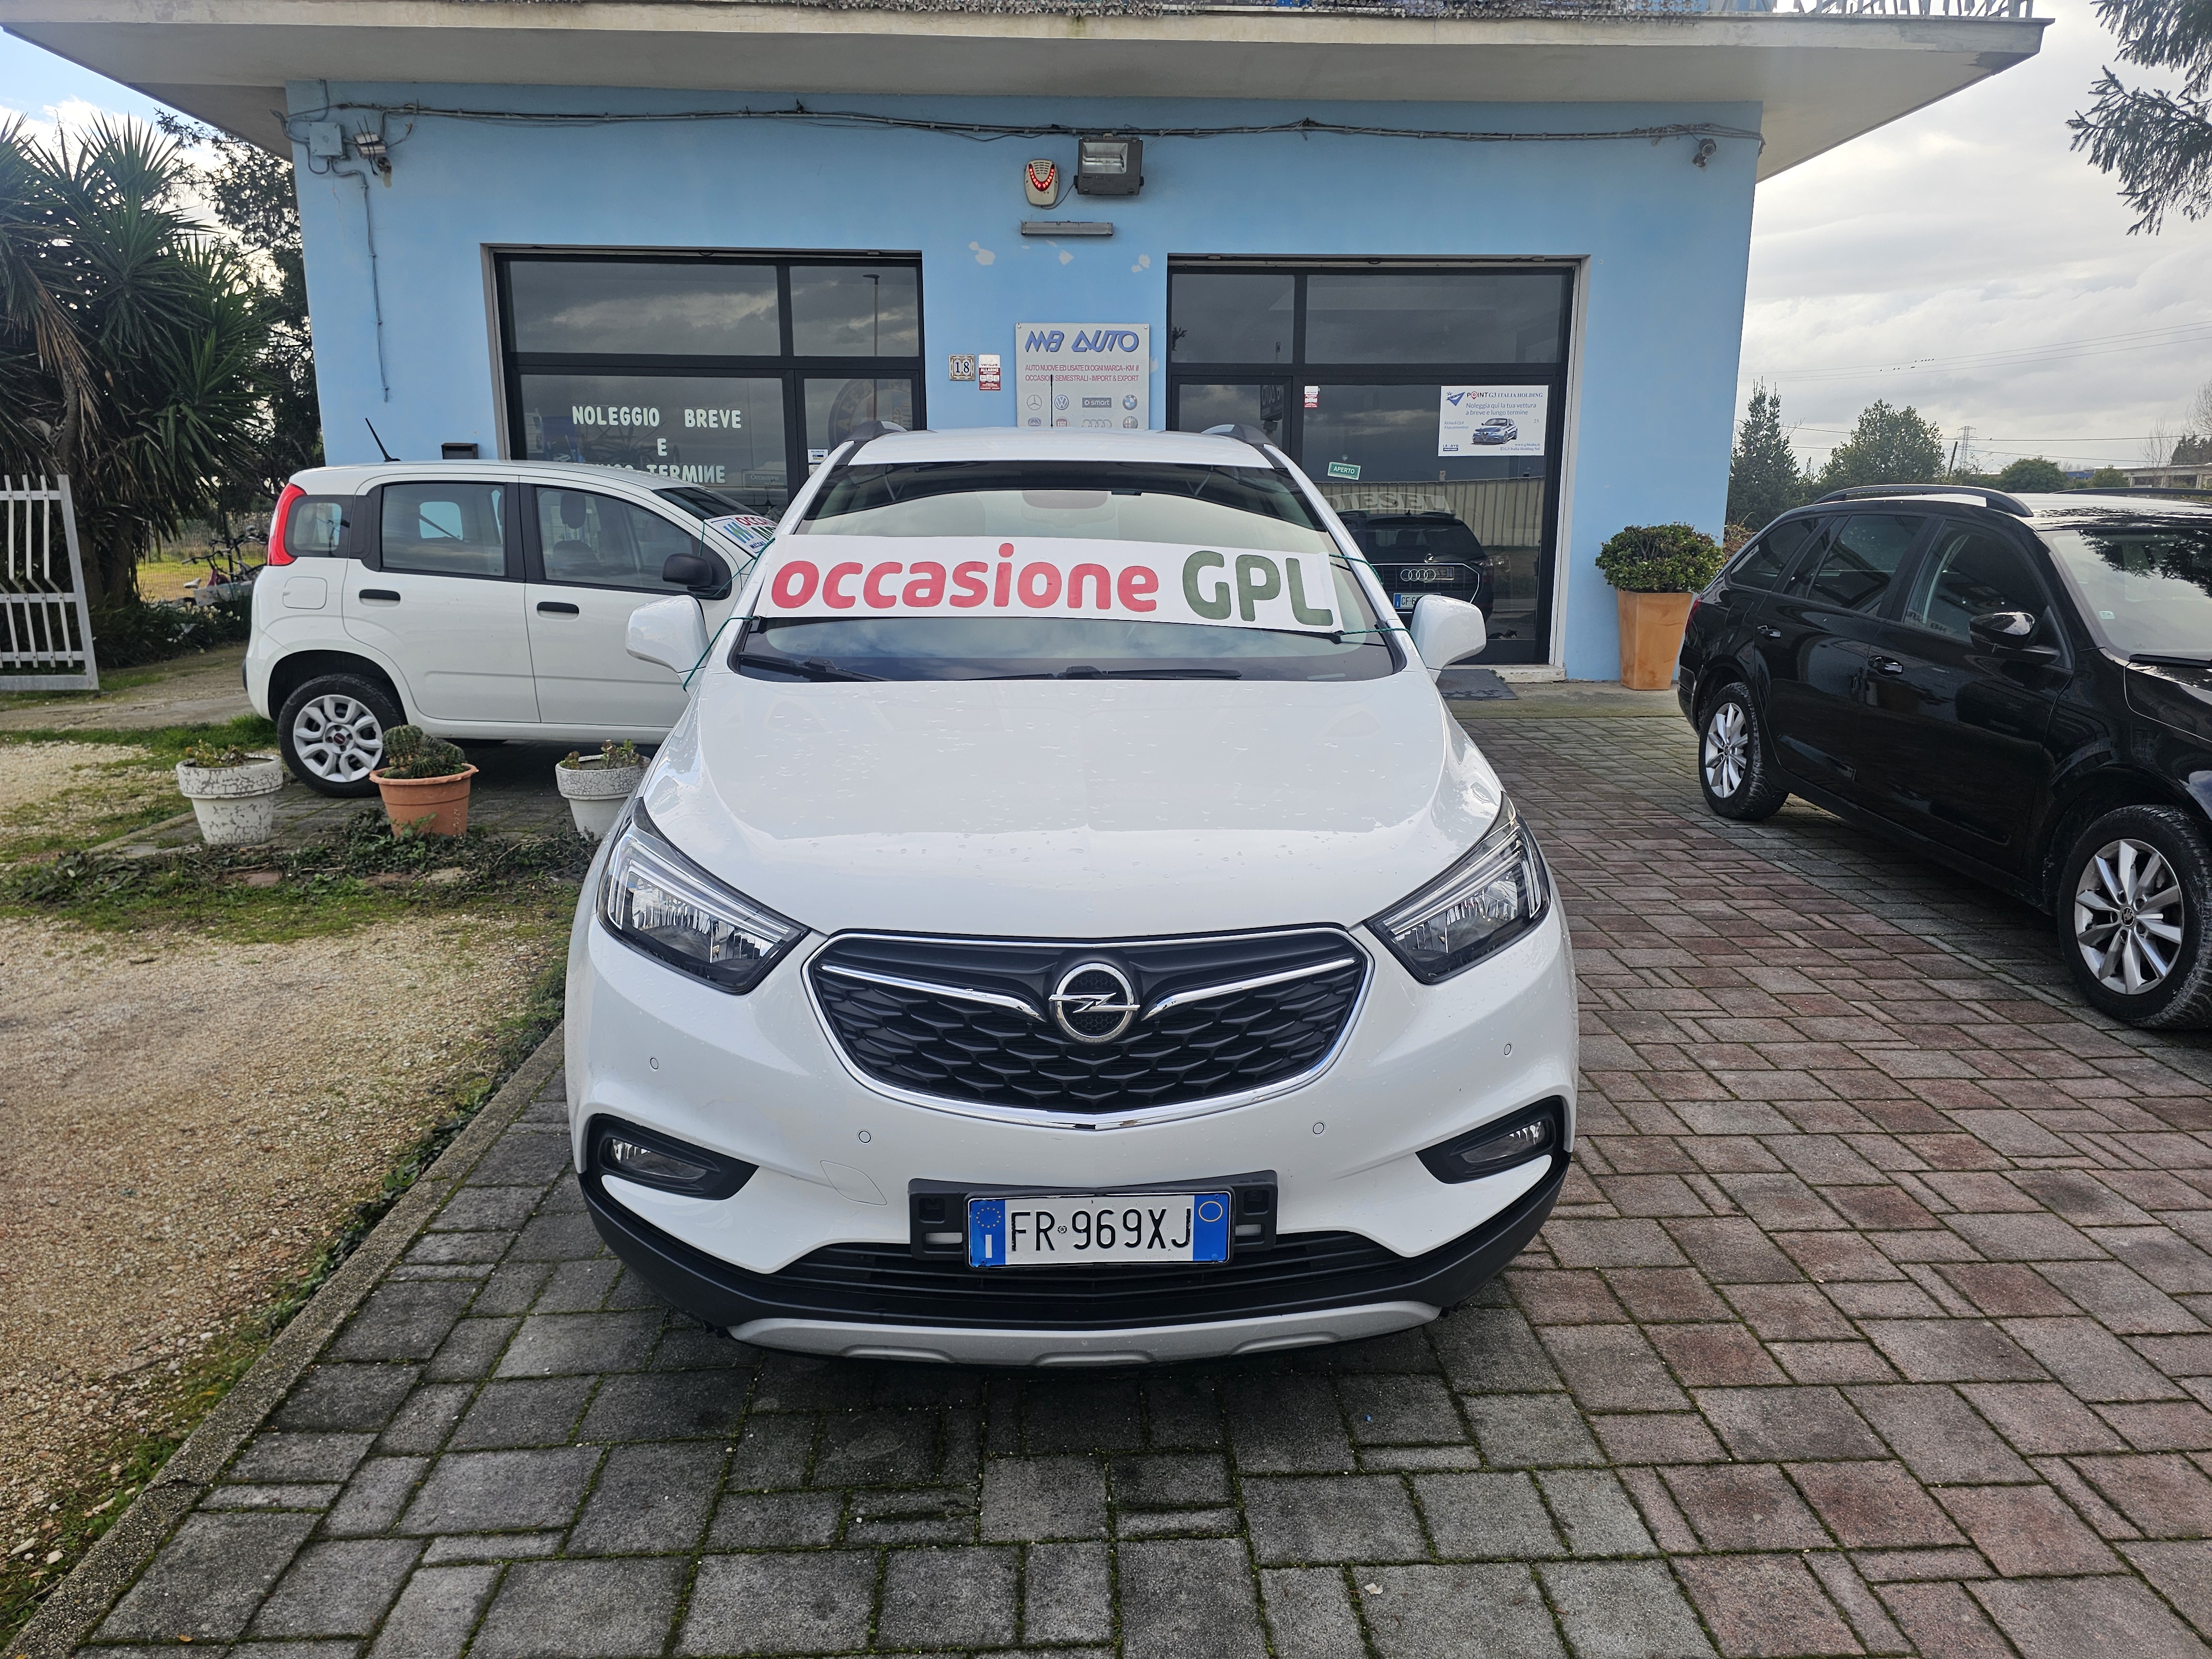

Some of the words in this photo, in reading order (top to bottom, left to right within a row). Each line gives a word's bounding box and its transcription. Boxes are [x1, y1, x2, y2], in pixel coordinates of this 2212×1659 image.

[1025, 331, 1065, 353] MB
[1071, 330, 1140, 353] AUTO
[956, 361, 970, 373] 18
[572, 406, 660, 427] NOLEGGIO
[684, 409, 742, 429] BREVE
[657, 438, 667, 456] E
[772, 543, 1159, 613] occasione
[1182, 551, 1333, 627] GPL
